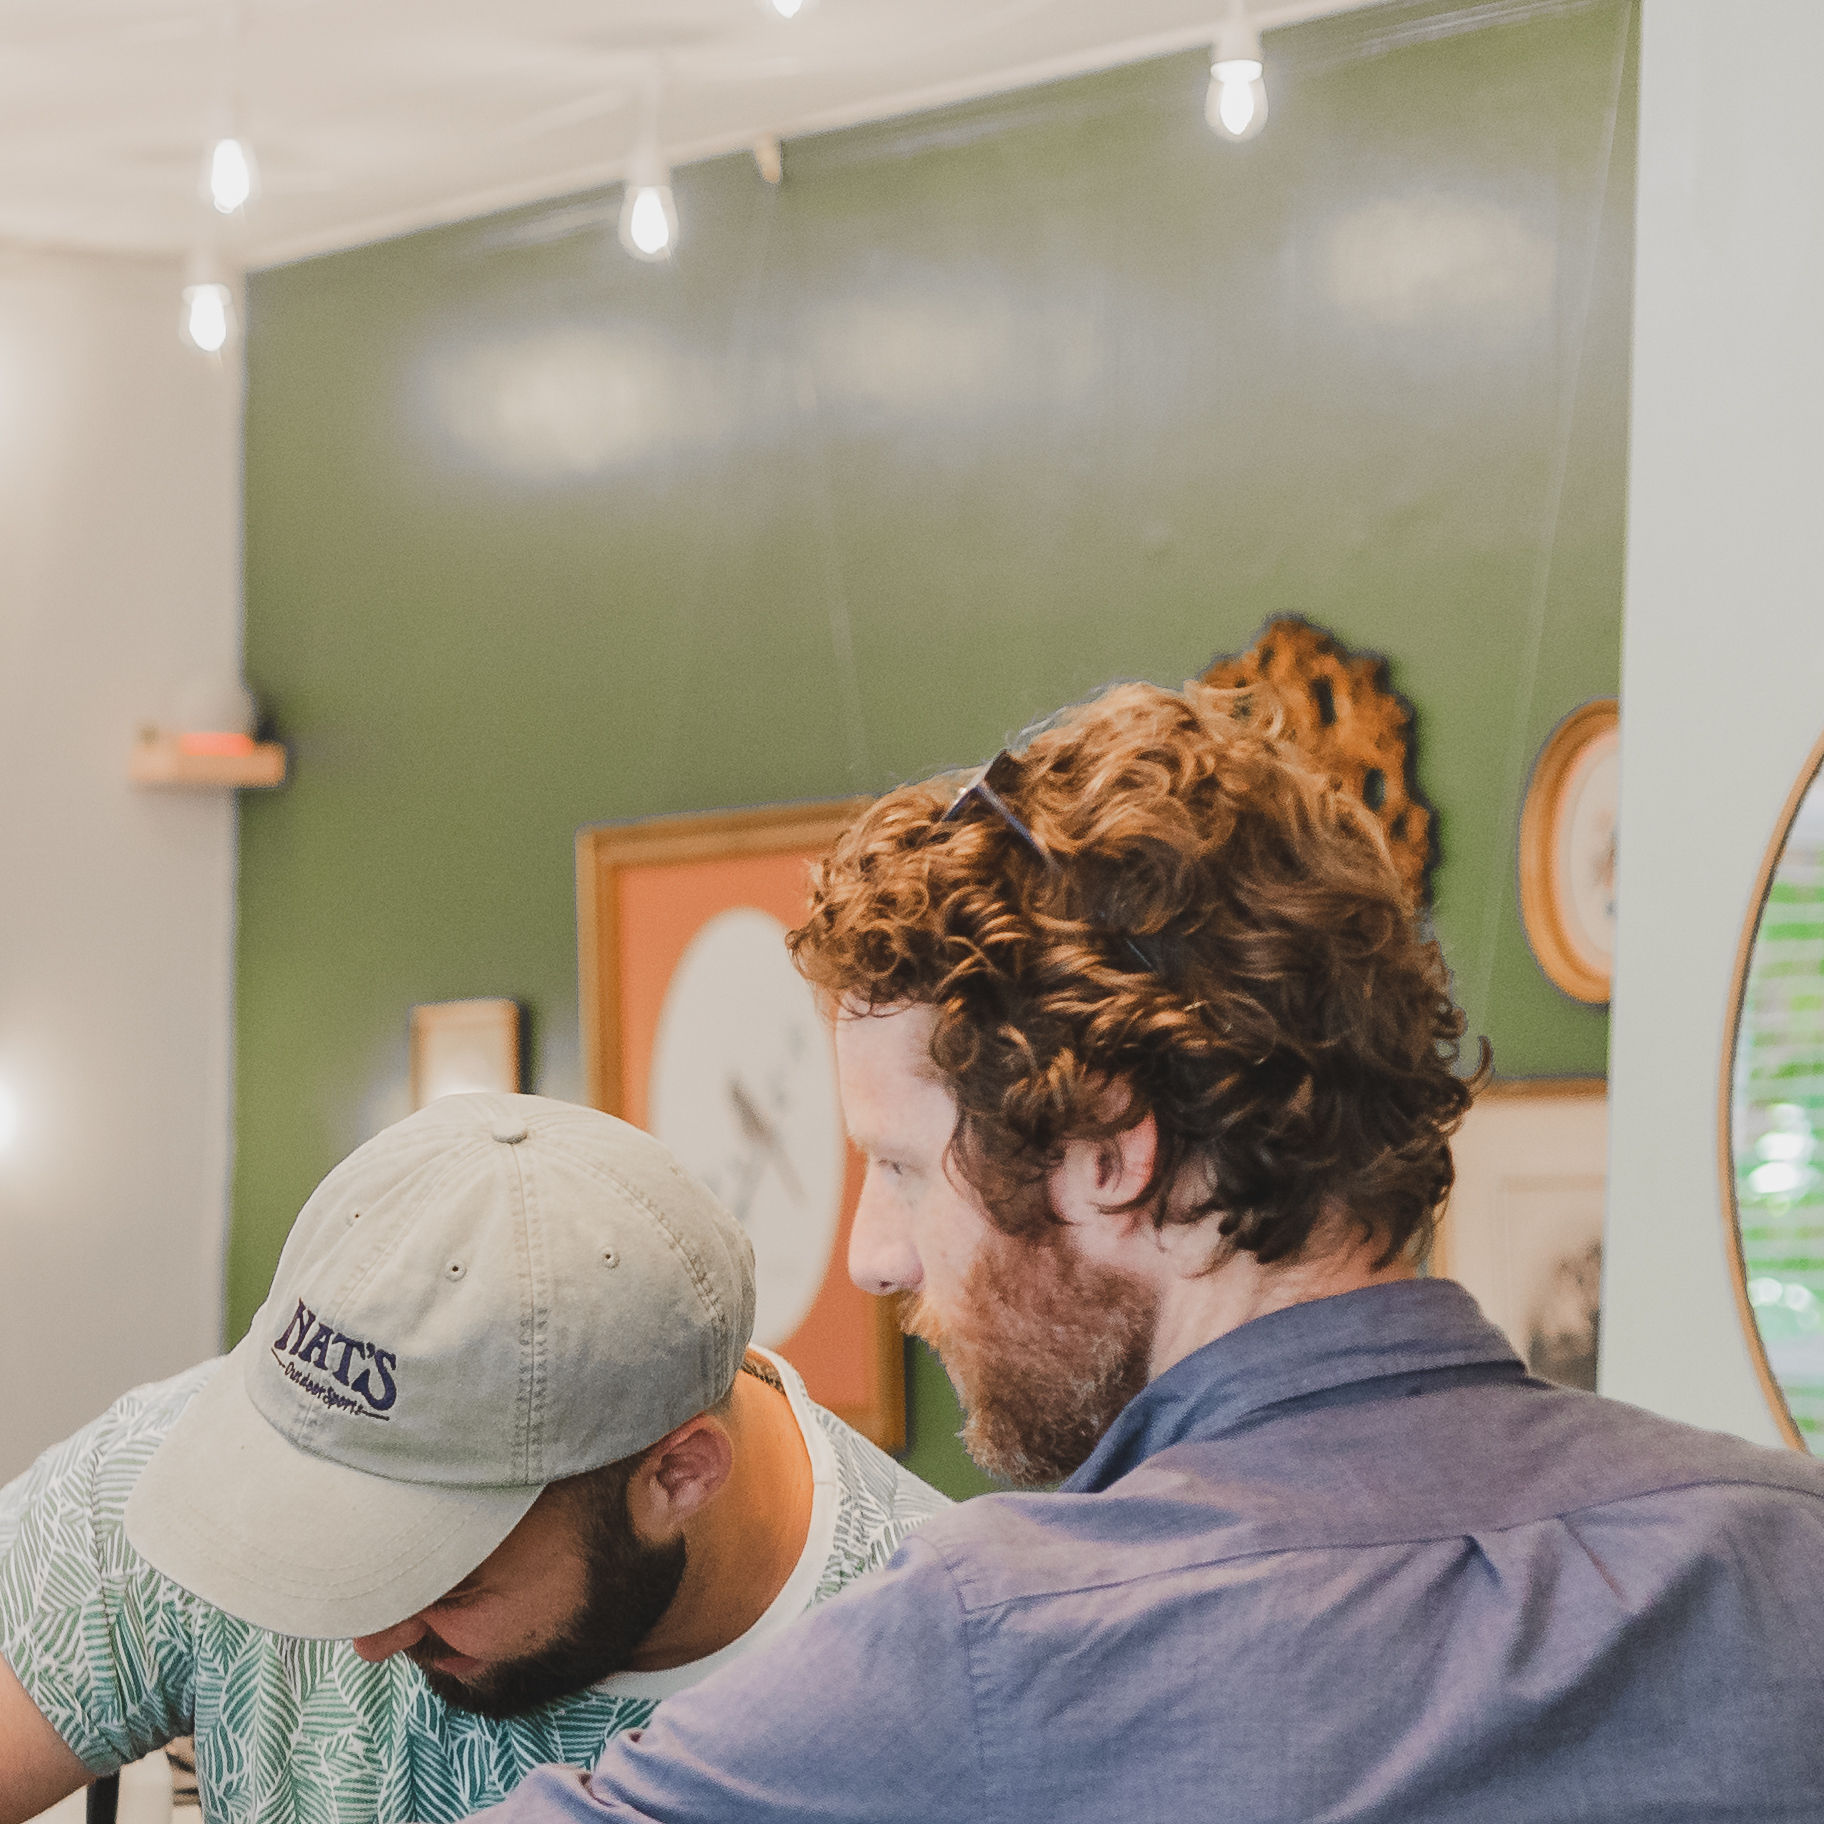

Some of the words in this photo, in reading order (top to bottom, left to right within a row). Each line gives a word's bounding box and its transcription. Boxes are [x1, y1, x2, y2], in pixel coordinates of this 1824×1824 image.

[273, 1297, 397, 1411] NAT'S
[284, 1361, 327, 1398] Outdoor
[322, 1386, 363, 1415] Sports
